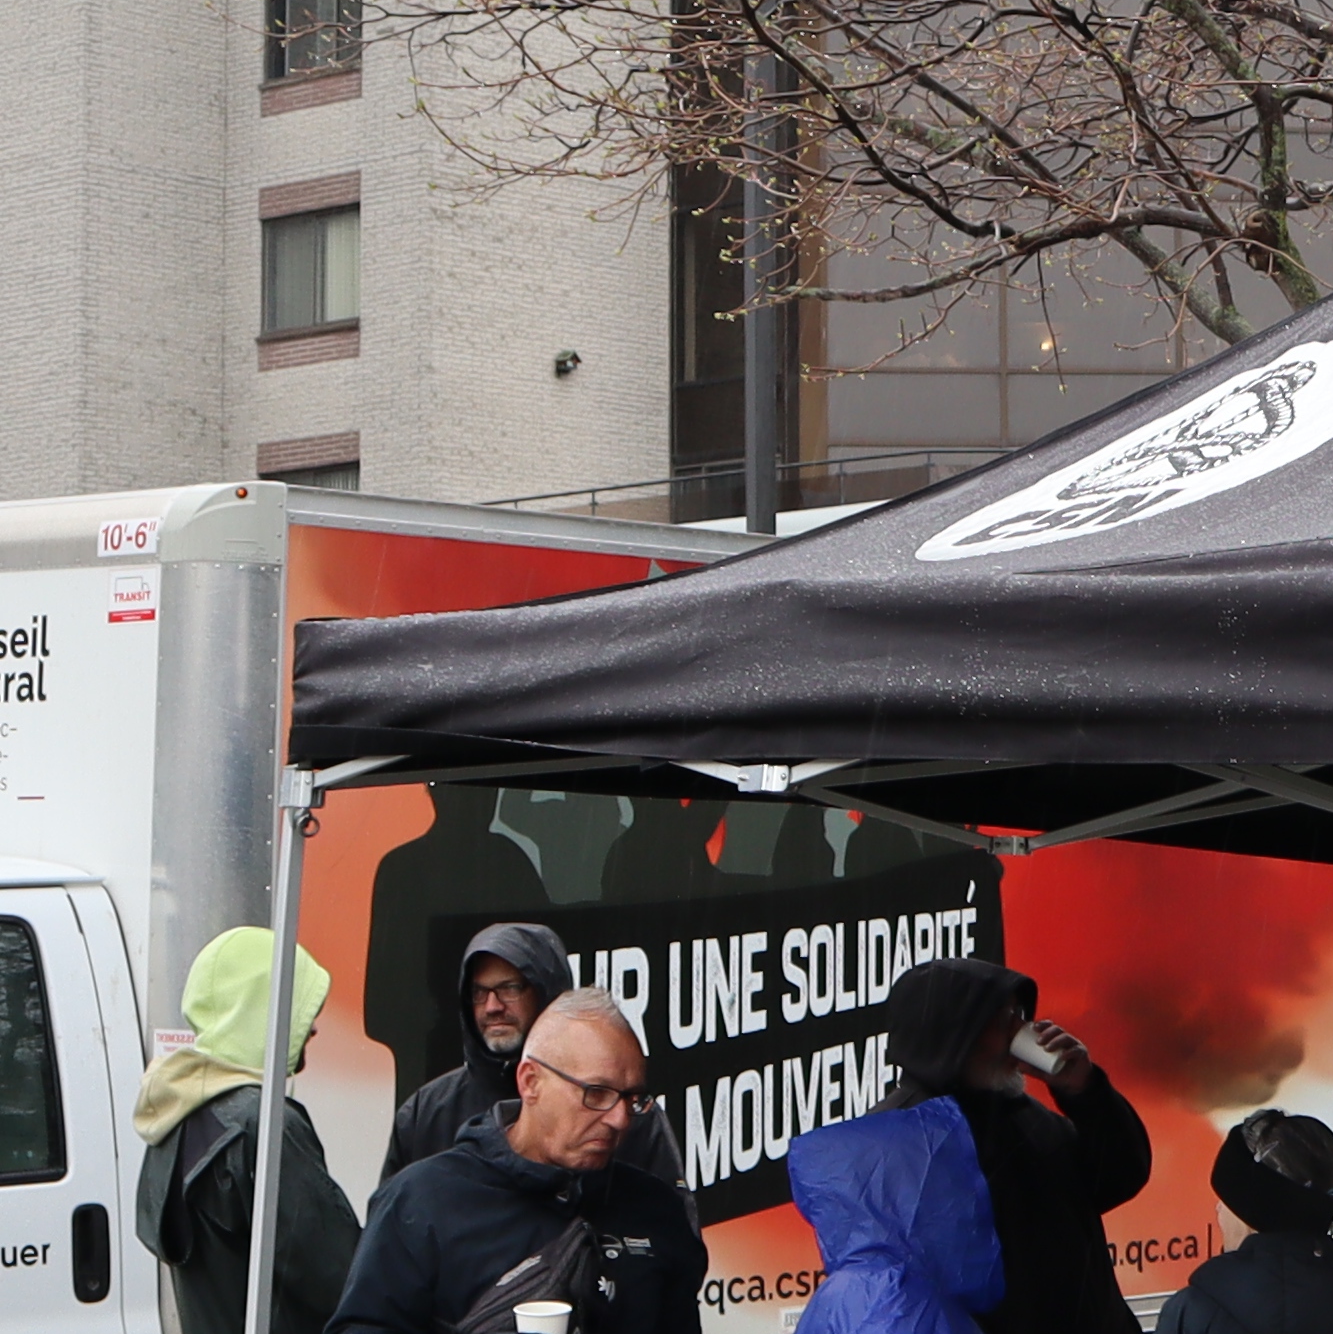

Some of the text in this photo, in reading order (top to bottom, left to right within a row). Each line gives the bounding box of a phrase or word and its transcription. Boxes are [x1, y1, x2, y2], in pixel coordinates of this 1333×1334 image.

[114, 590, 151, 603] TRANSIT
[0, 658, 47, 703] ral
[669, 930, 768, 1050] UNE
[781, 879, 978, 1024] SOLIDARITÉ
[686, 1032, 903, 1192] MOUVEME
